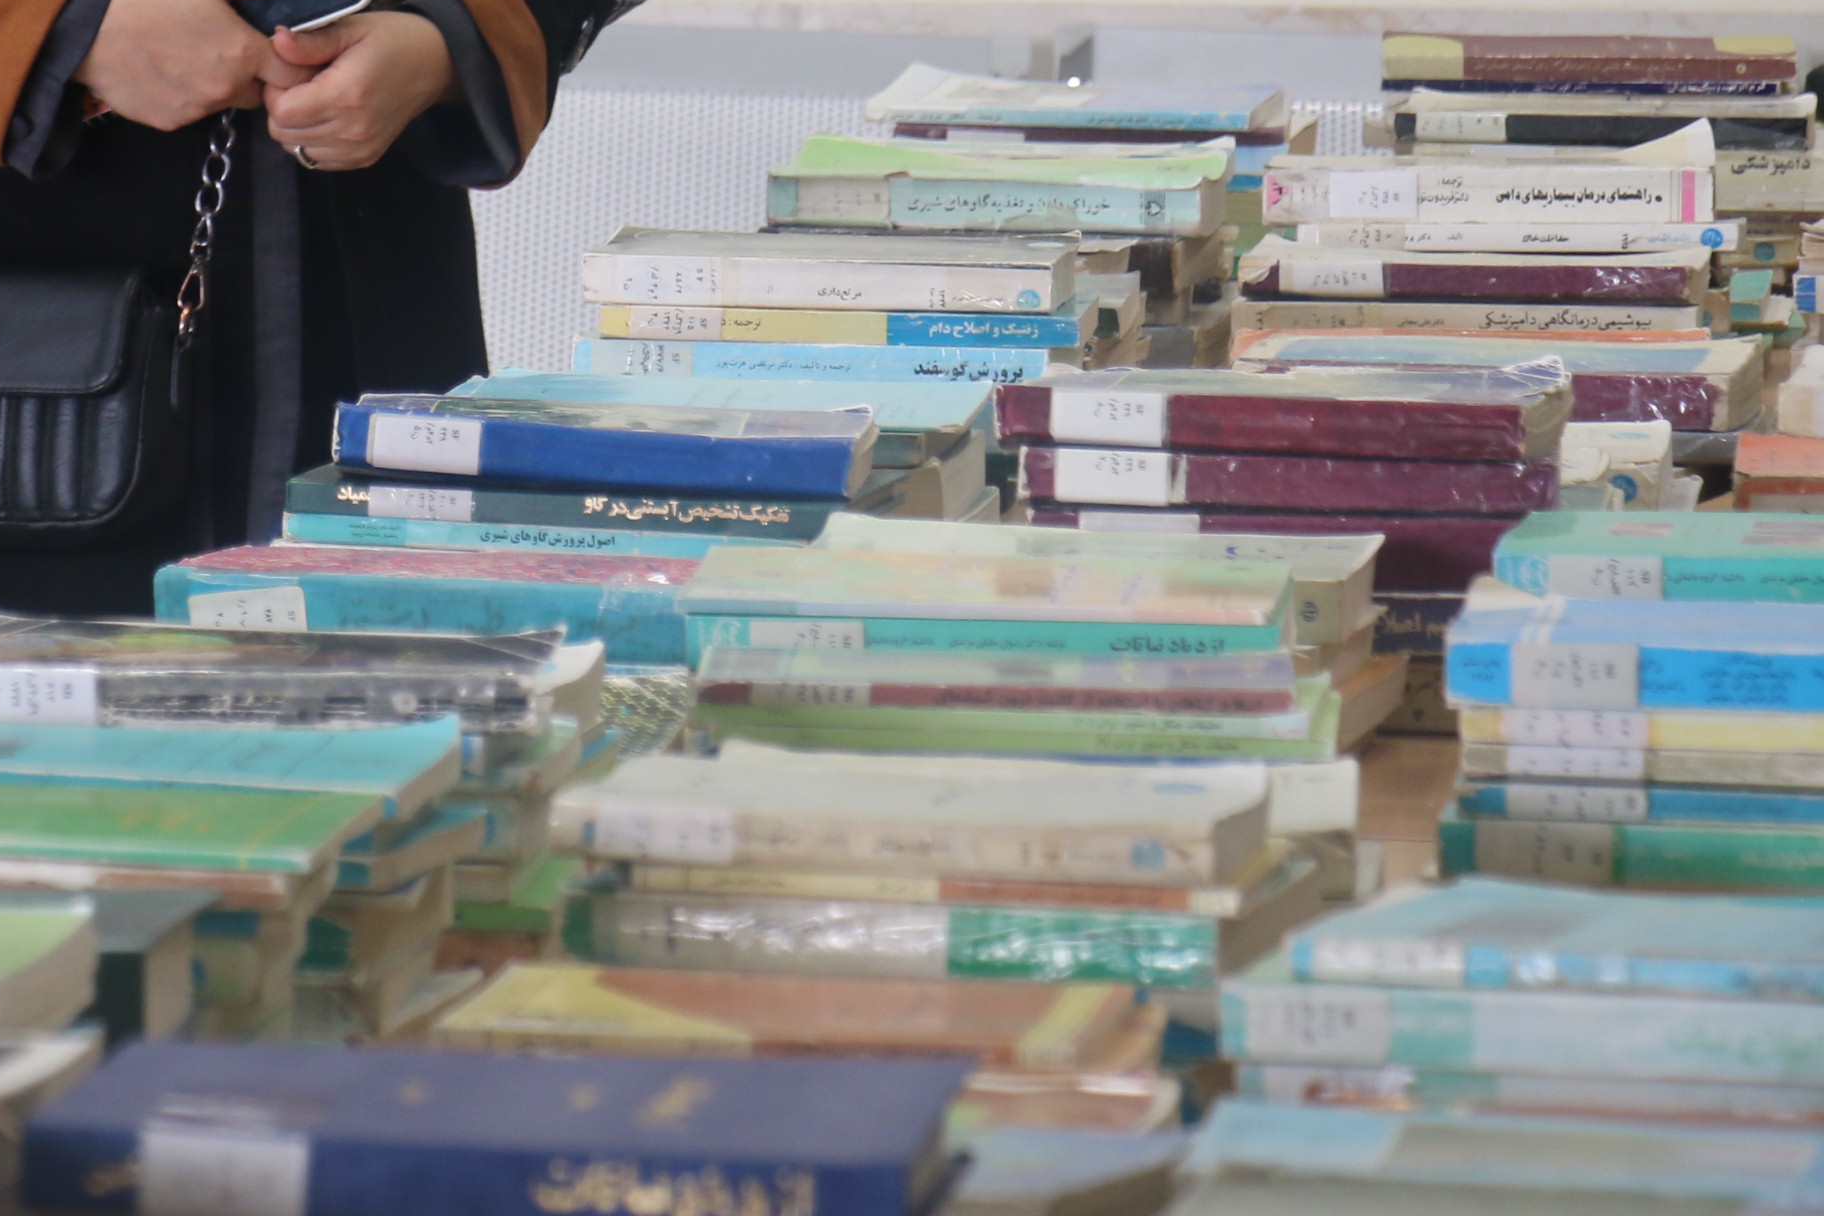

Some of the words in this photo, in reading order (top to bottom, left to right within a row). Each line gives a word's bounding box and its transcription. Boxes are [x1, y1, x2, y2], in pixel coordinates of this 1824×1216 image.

[1607, 187, 1651, 204] راهنمای
[929, 322, 952, 337] دام
[953, 322, 990, 338] اصلاح
[992, 327, 1000, 338] و
[1136, 404, 1144, 416] SF
[452, 429, 460, 441] SF
[1138, 460, 1146, 472] SF
[583, 496, 608, 514] گاو
[608, 501, 627, 517] در
[678, 503, 739, 523] تشخیص
[480, 529, 509, 544] شیری
[510, 529, 549, 546] گاوهای
[548, 532, 585, 548] پرورش
[586, 534, 616, 549] اصول
